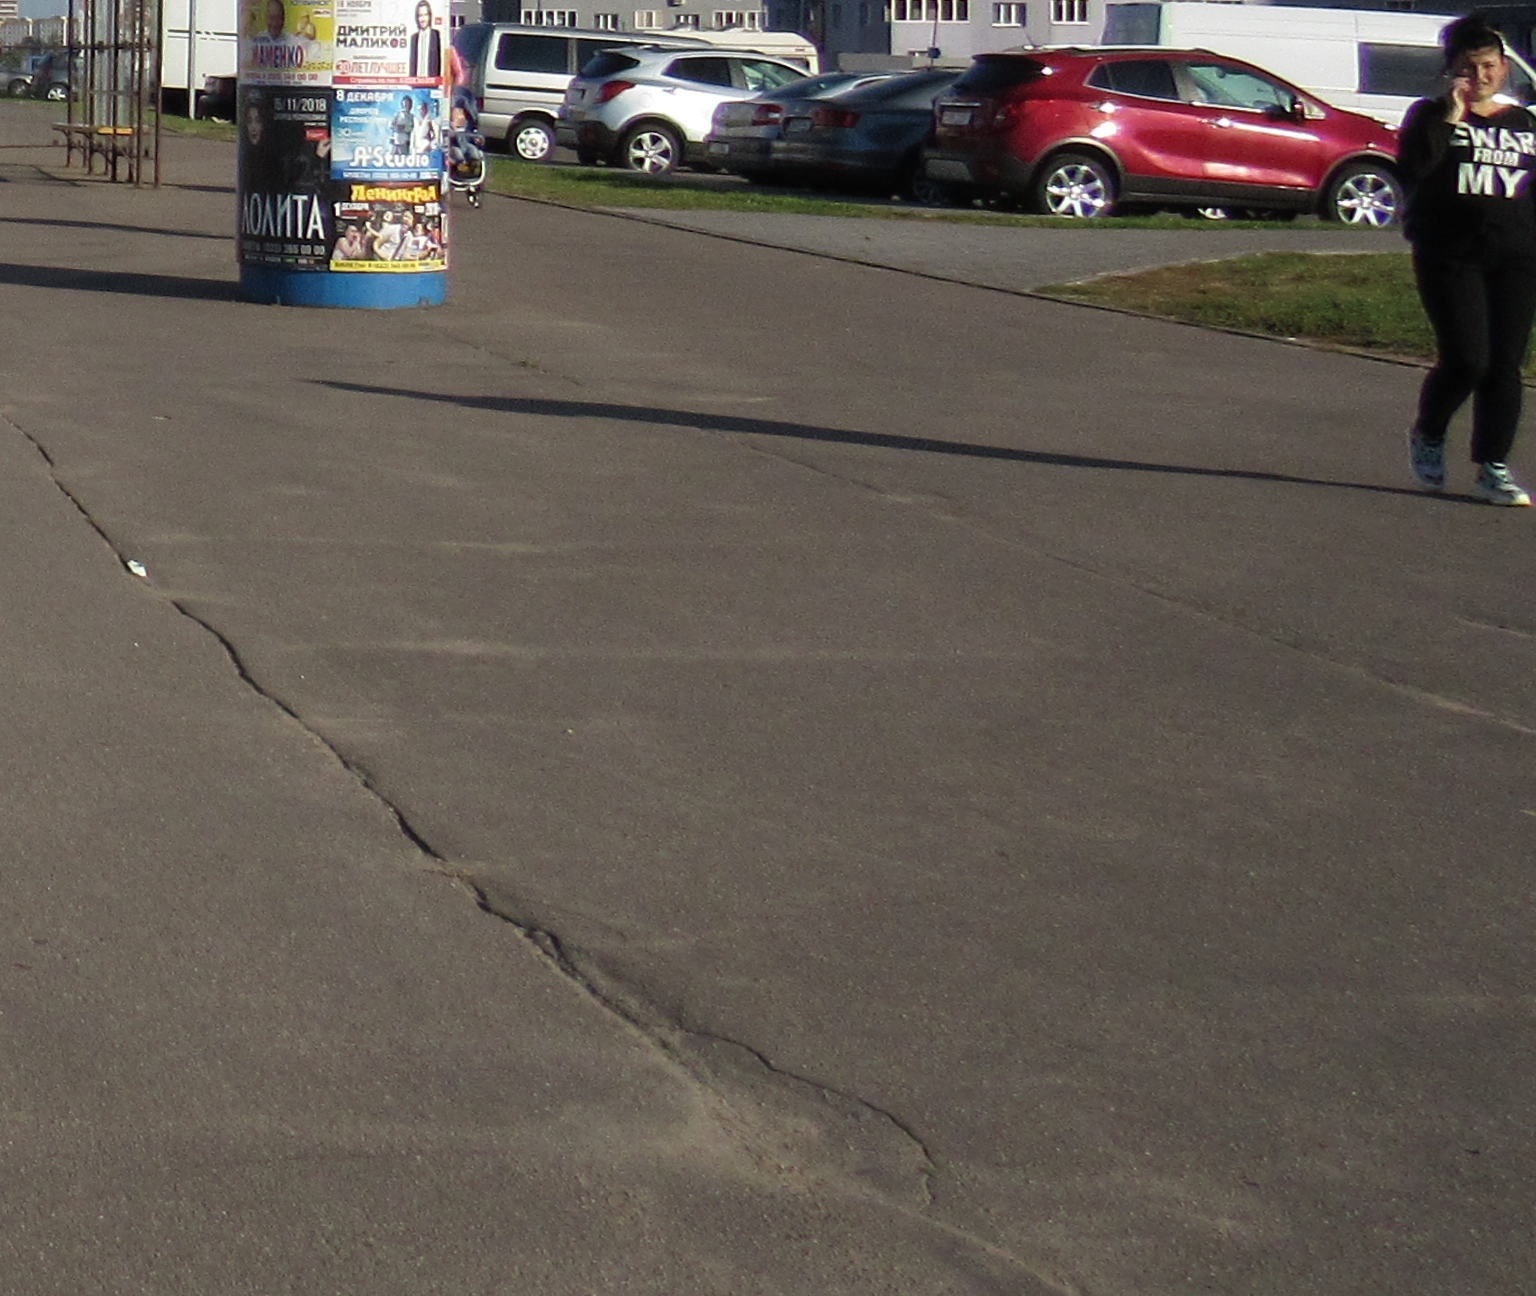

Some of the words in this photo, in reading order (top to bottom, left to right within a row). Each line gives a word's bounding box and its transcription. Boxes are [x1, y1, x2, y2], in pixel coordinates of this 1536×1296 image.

[336, 24, 407, 37] ДМИТРИЙ
[335, 37, 408, 49] МАЛИКОВ
[335, 89, 345, 102] 8
[346, 91, 395, 103] ДЕКАБРЯ
[349, 145, 430, 168] A'Studio
[1473, 147, 1519, 167] FROM
[1458, 162, 1528, 199] MY
[241, 192, 326, 239] ЛОЛИТА
